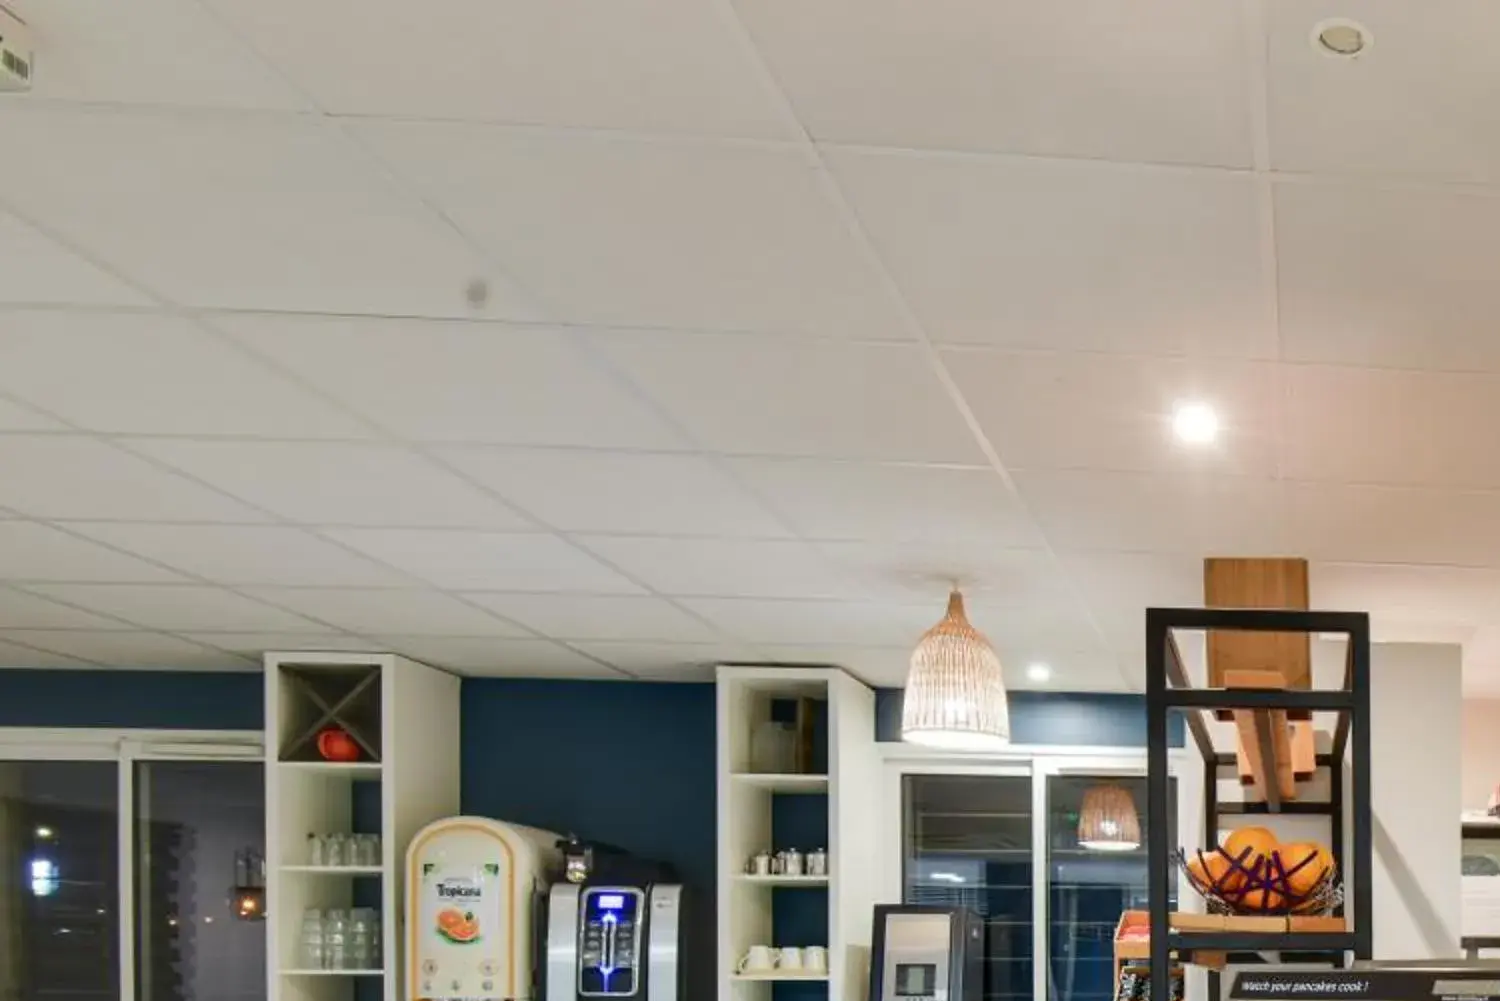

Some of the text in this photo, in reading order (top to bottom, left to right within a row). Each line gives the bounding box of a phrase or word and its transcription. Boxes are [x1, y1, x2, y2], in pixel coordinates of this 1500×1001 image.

[436, 883, 481, 897] Tropicana
[1270, 982, 1291, 993] your
[1292, 981, 1337, 993] pancakes
